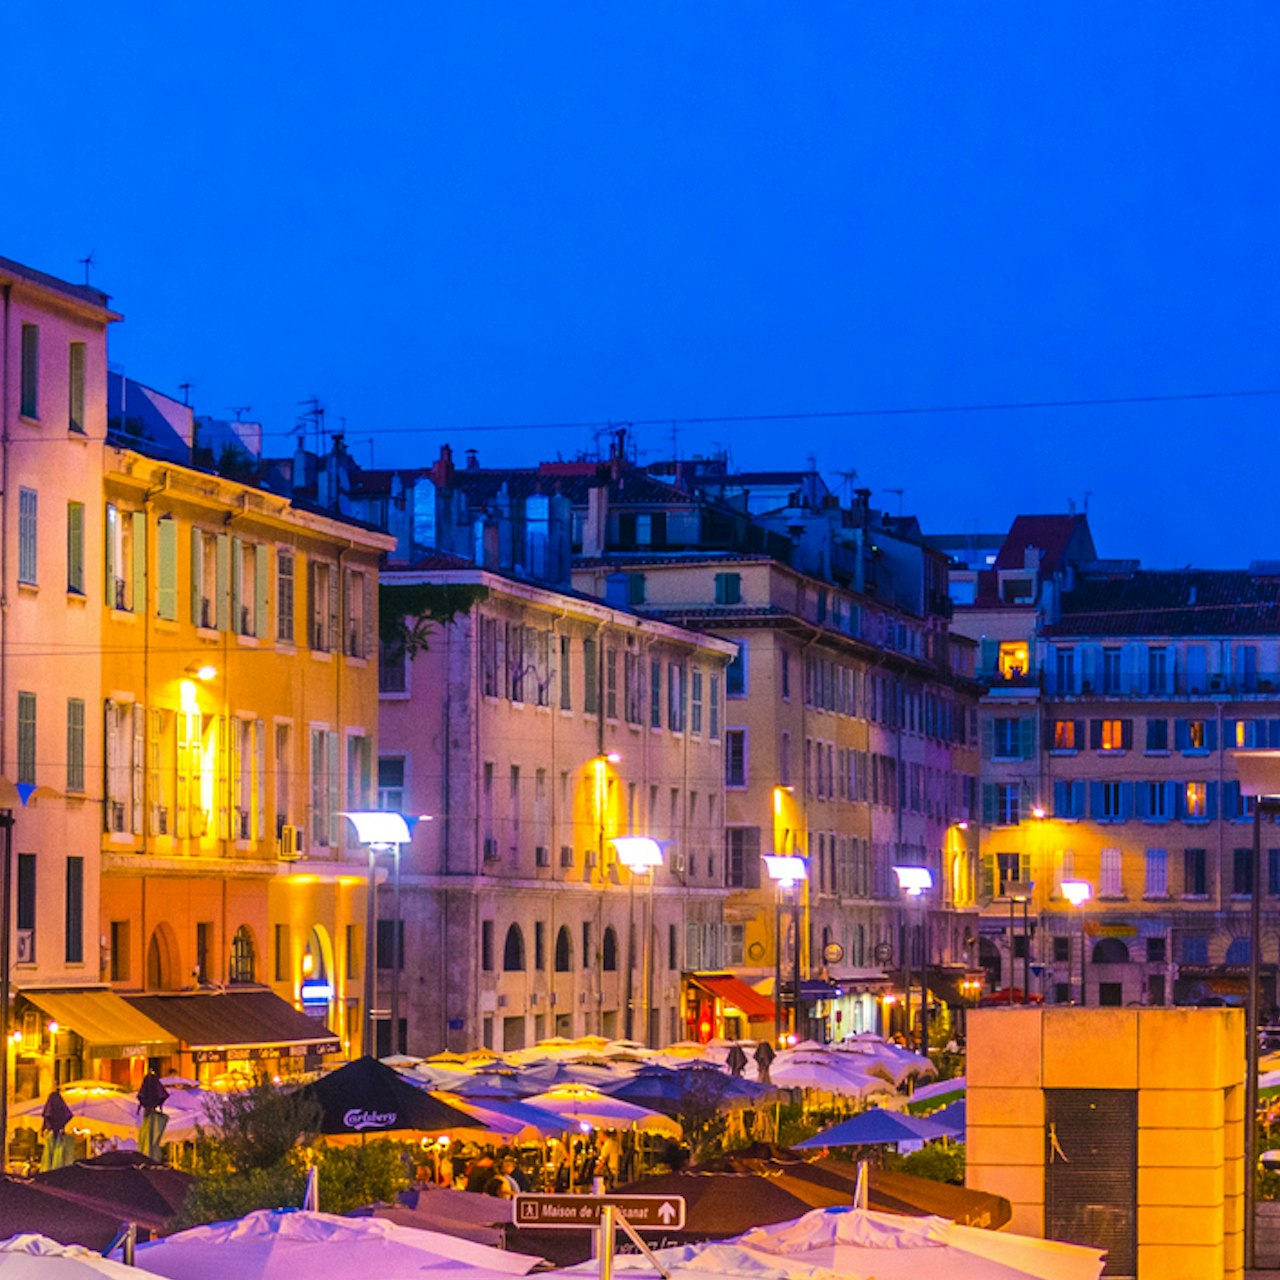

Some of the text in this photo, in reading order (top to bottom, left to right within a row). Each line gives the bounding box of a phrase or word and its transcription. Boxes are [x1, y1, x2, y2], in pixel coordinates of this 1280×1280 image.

[343, 1108, 398, 1130] Carlsberg
[541, 1204, 577, 1218] Maison
[579, 1204, 592, 1218] de
